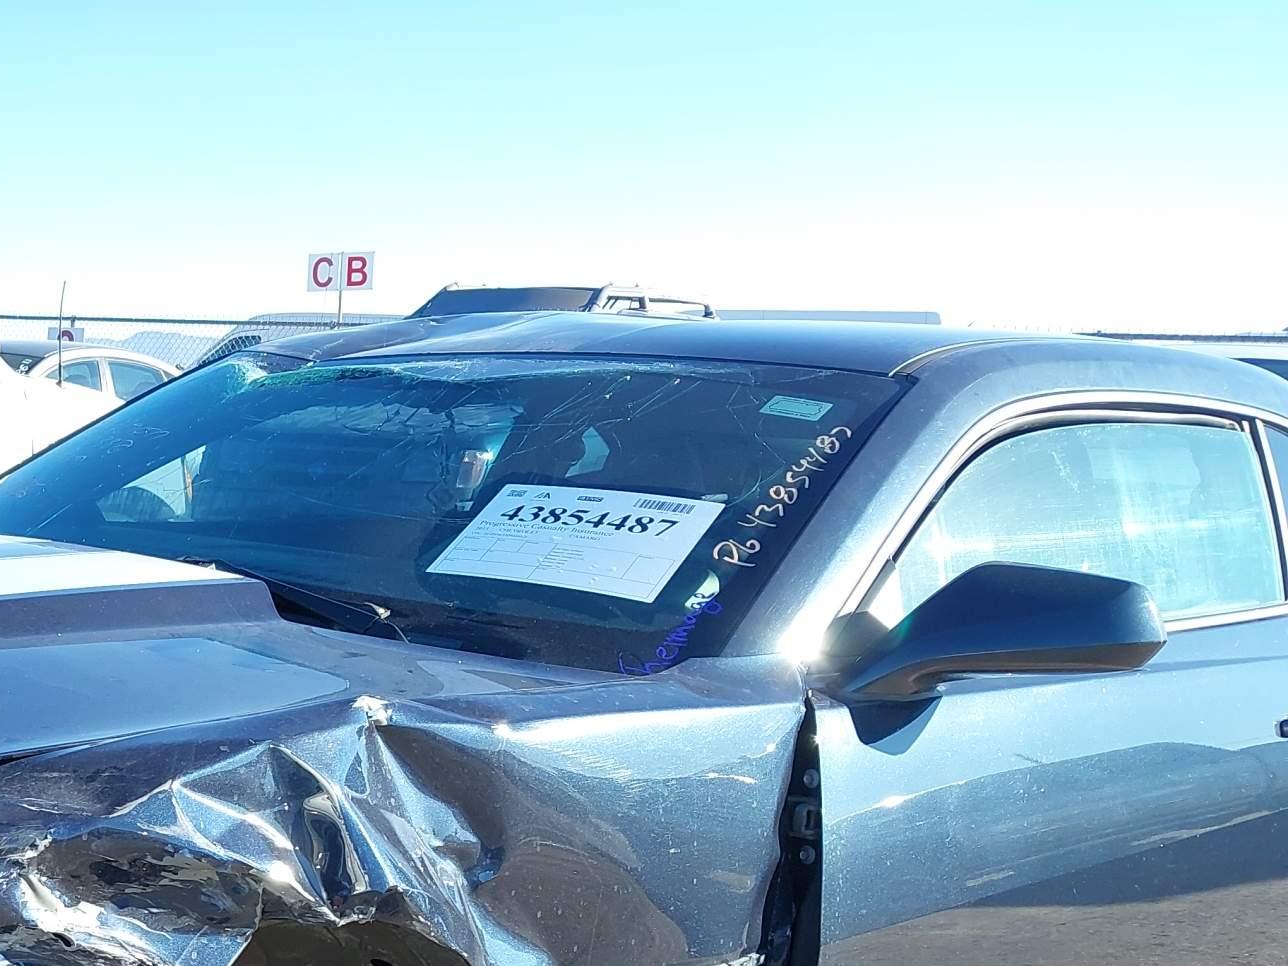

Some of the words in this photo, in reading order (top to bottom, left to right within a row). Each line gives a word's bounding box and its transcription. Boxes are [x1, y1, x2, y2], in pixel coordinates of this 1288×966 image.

[313, 256, 334, 288] C
[346, 256, 368, 287] B
[479, 520, 530, 530] Progressive
[500, 504, 680, 537] 43854487
